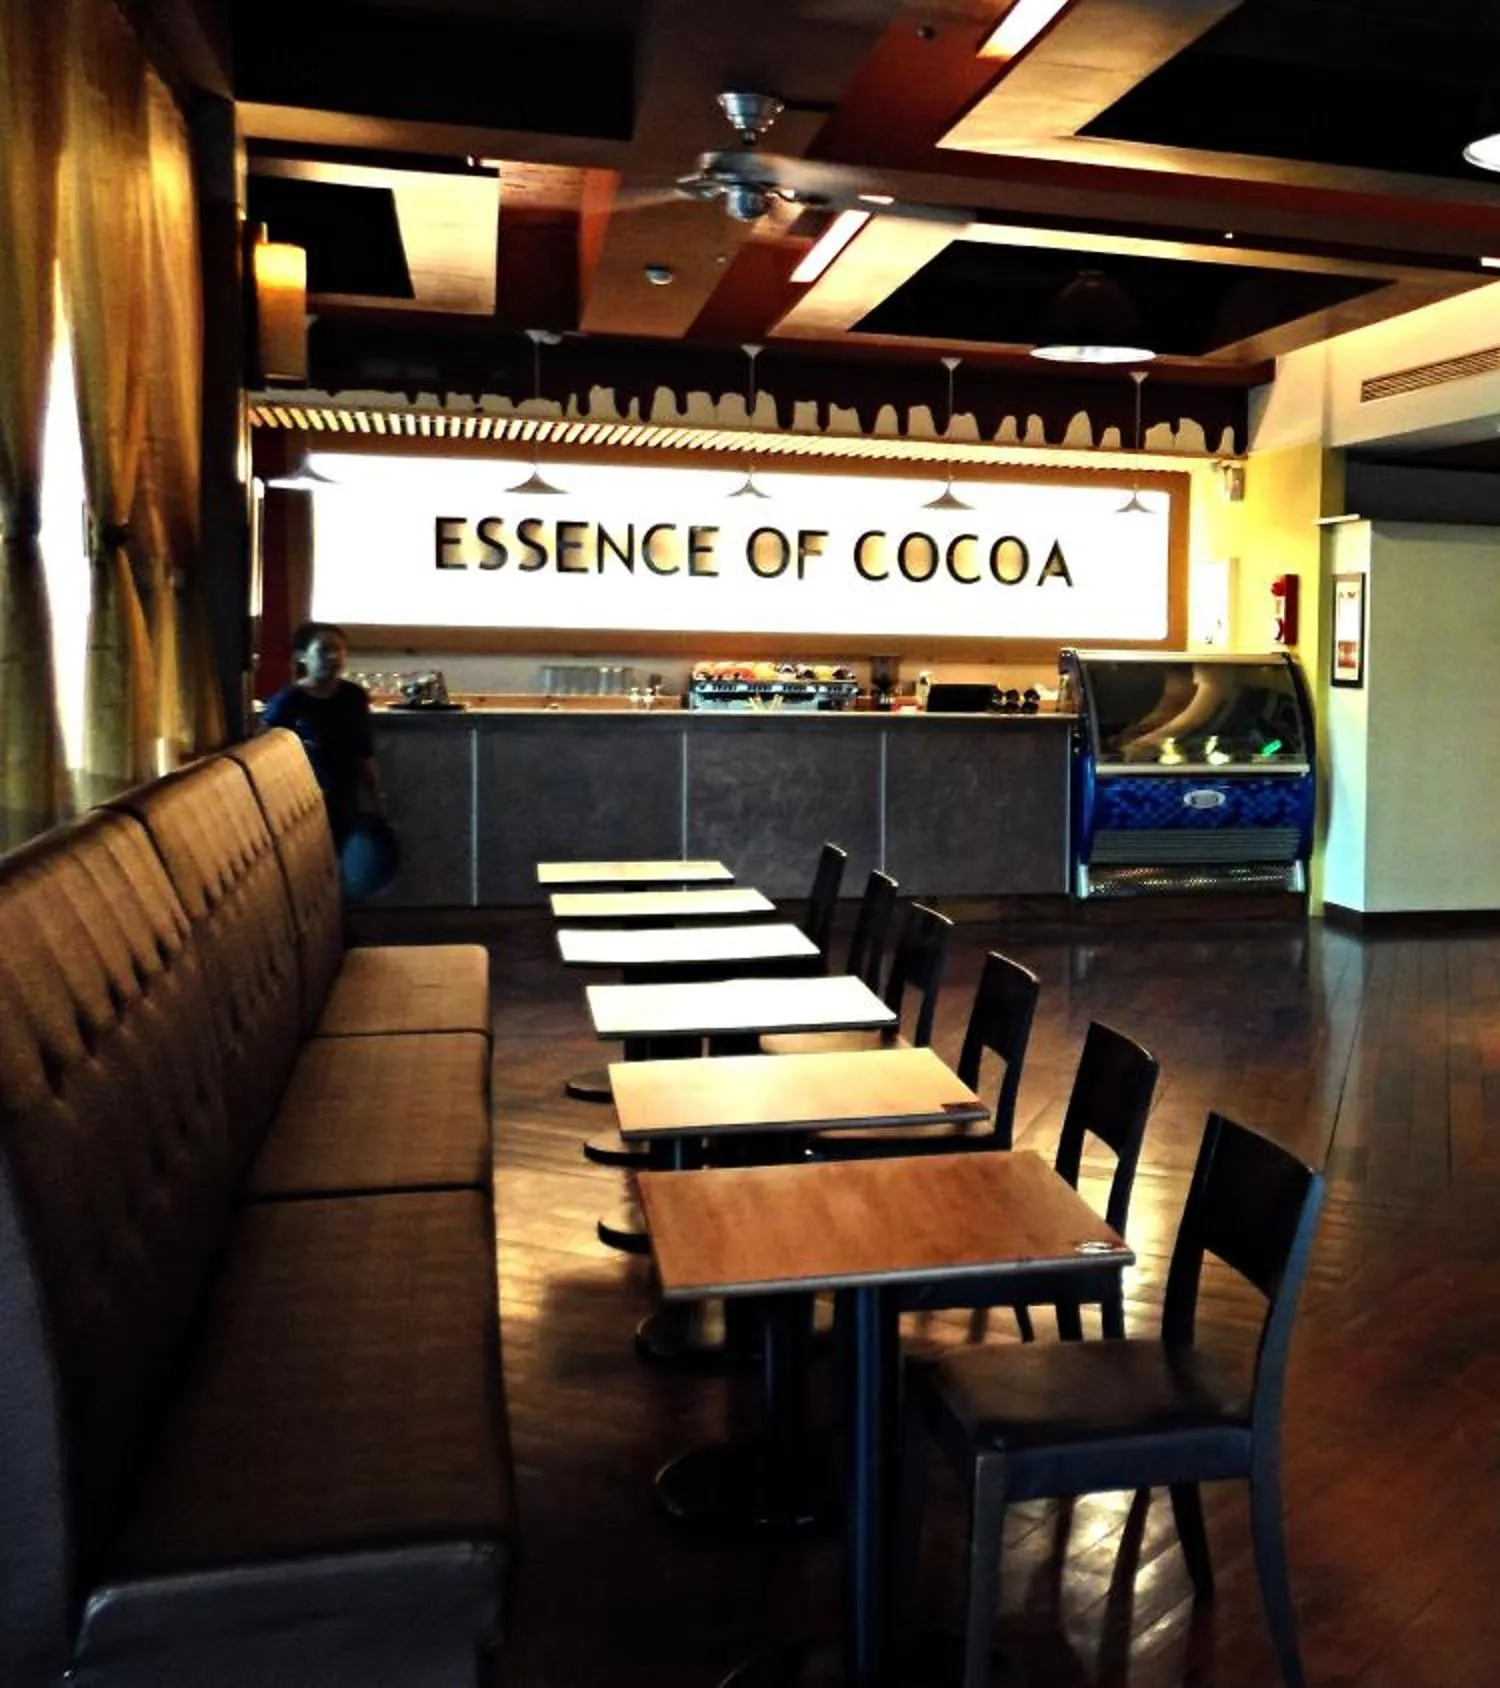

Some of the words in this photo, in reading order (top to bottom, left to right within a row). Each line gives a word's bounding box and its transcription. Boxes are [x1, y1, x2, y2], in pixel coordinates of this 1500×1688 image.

[434, 515, 720, 577] ESSENCE
[745, 526, 829, 580] OF
[853, 530, 1073, 587] COCOA
